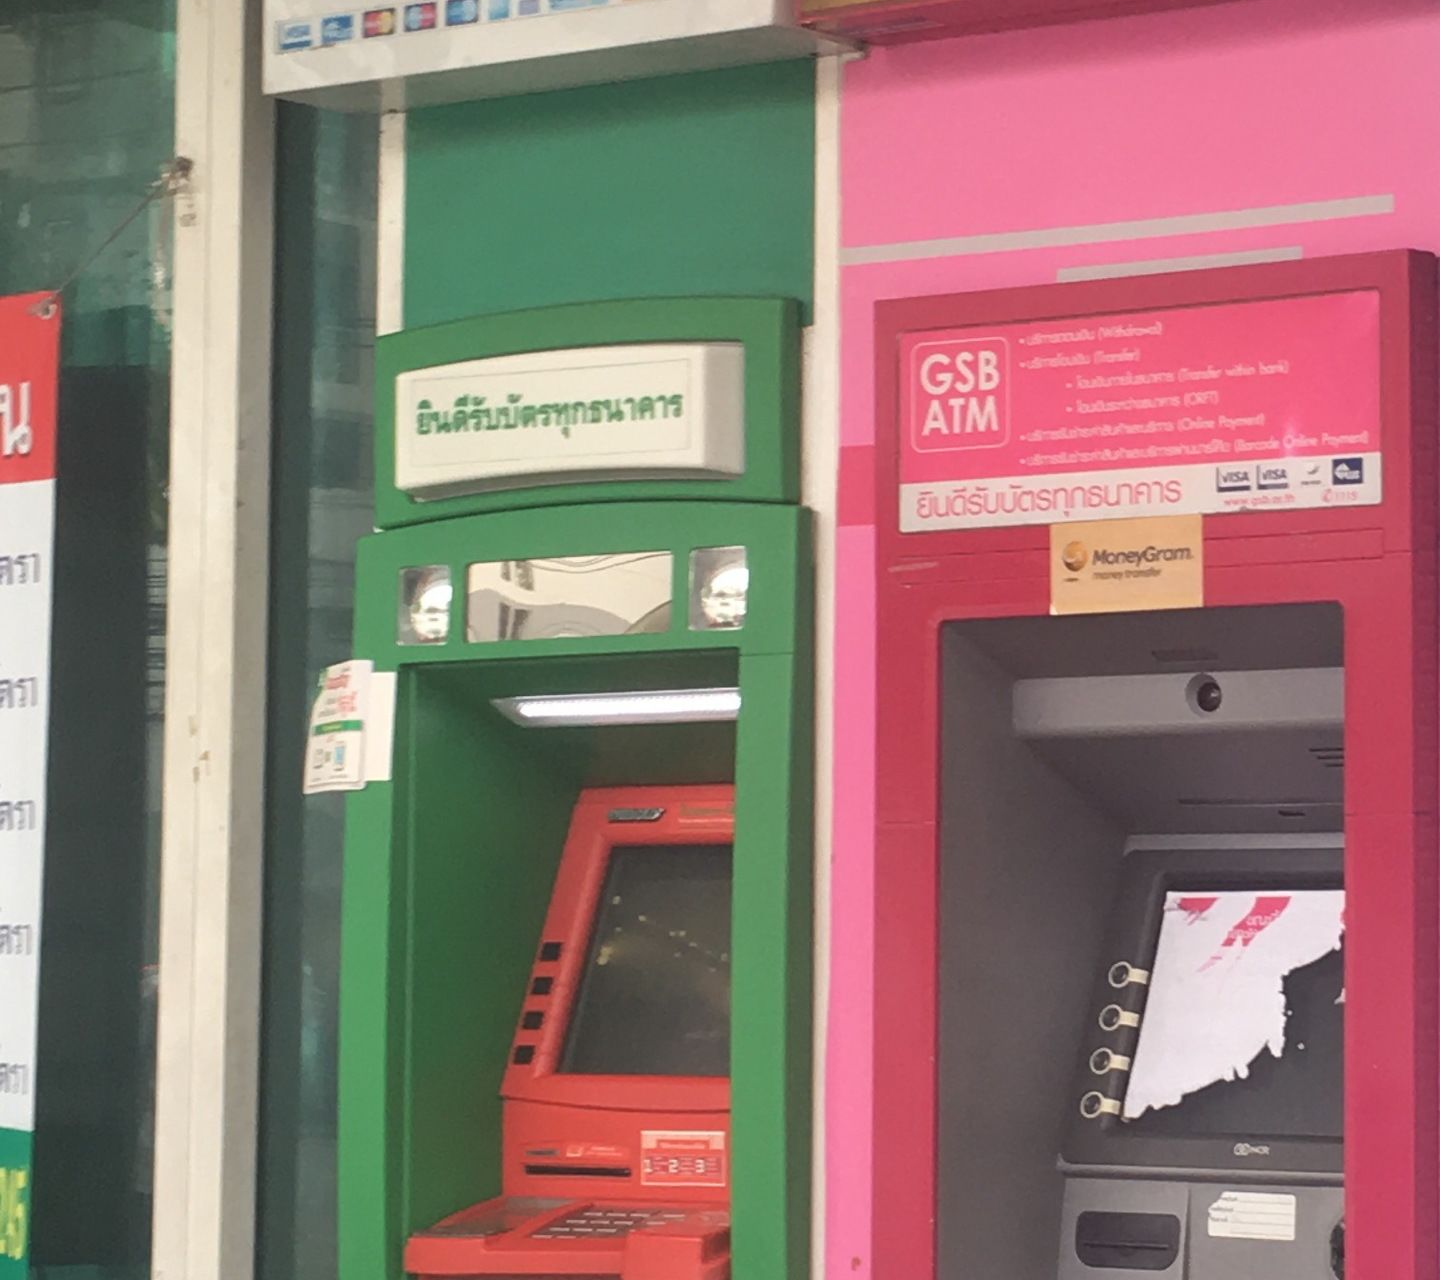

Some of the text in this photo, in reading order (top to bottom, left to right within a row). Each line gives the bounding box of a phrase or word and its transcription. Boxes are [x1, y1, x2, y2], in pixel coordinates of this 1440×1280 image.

[920, 349, 999, 396] GSB
[416, 393, 684, 438] ยินดีรับบัตรทุกธนาคาร
[922, 395, 999, 436] ATM
[916, 480, 1182, 518] ยินดีรับบัตรทุกธนาคาร
